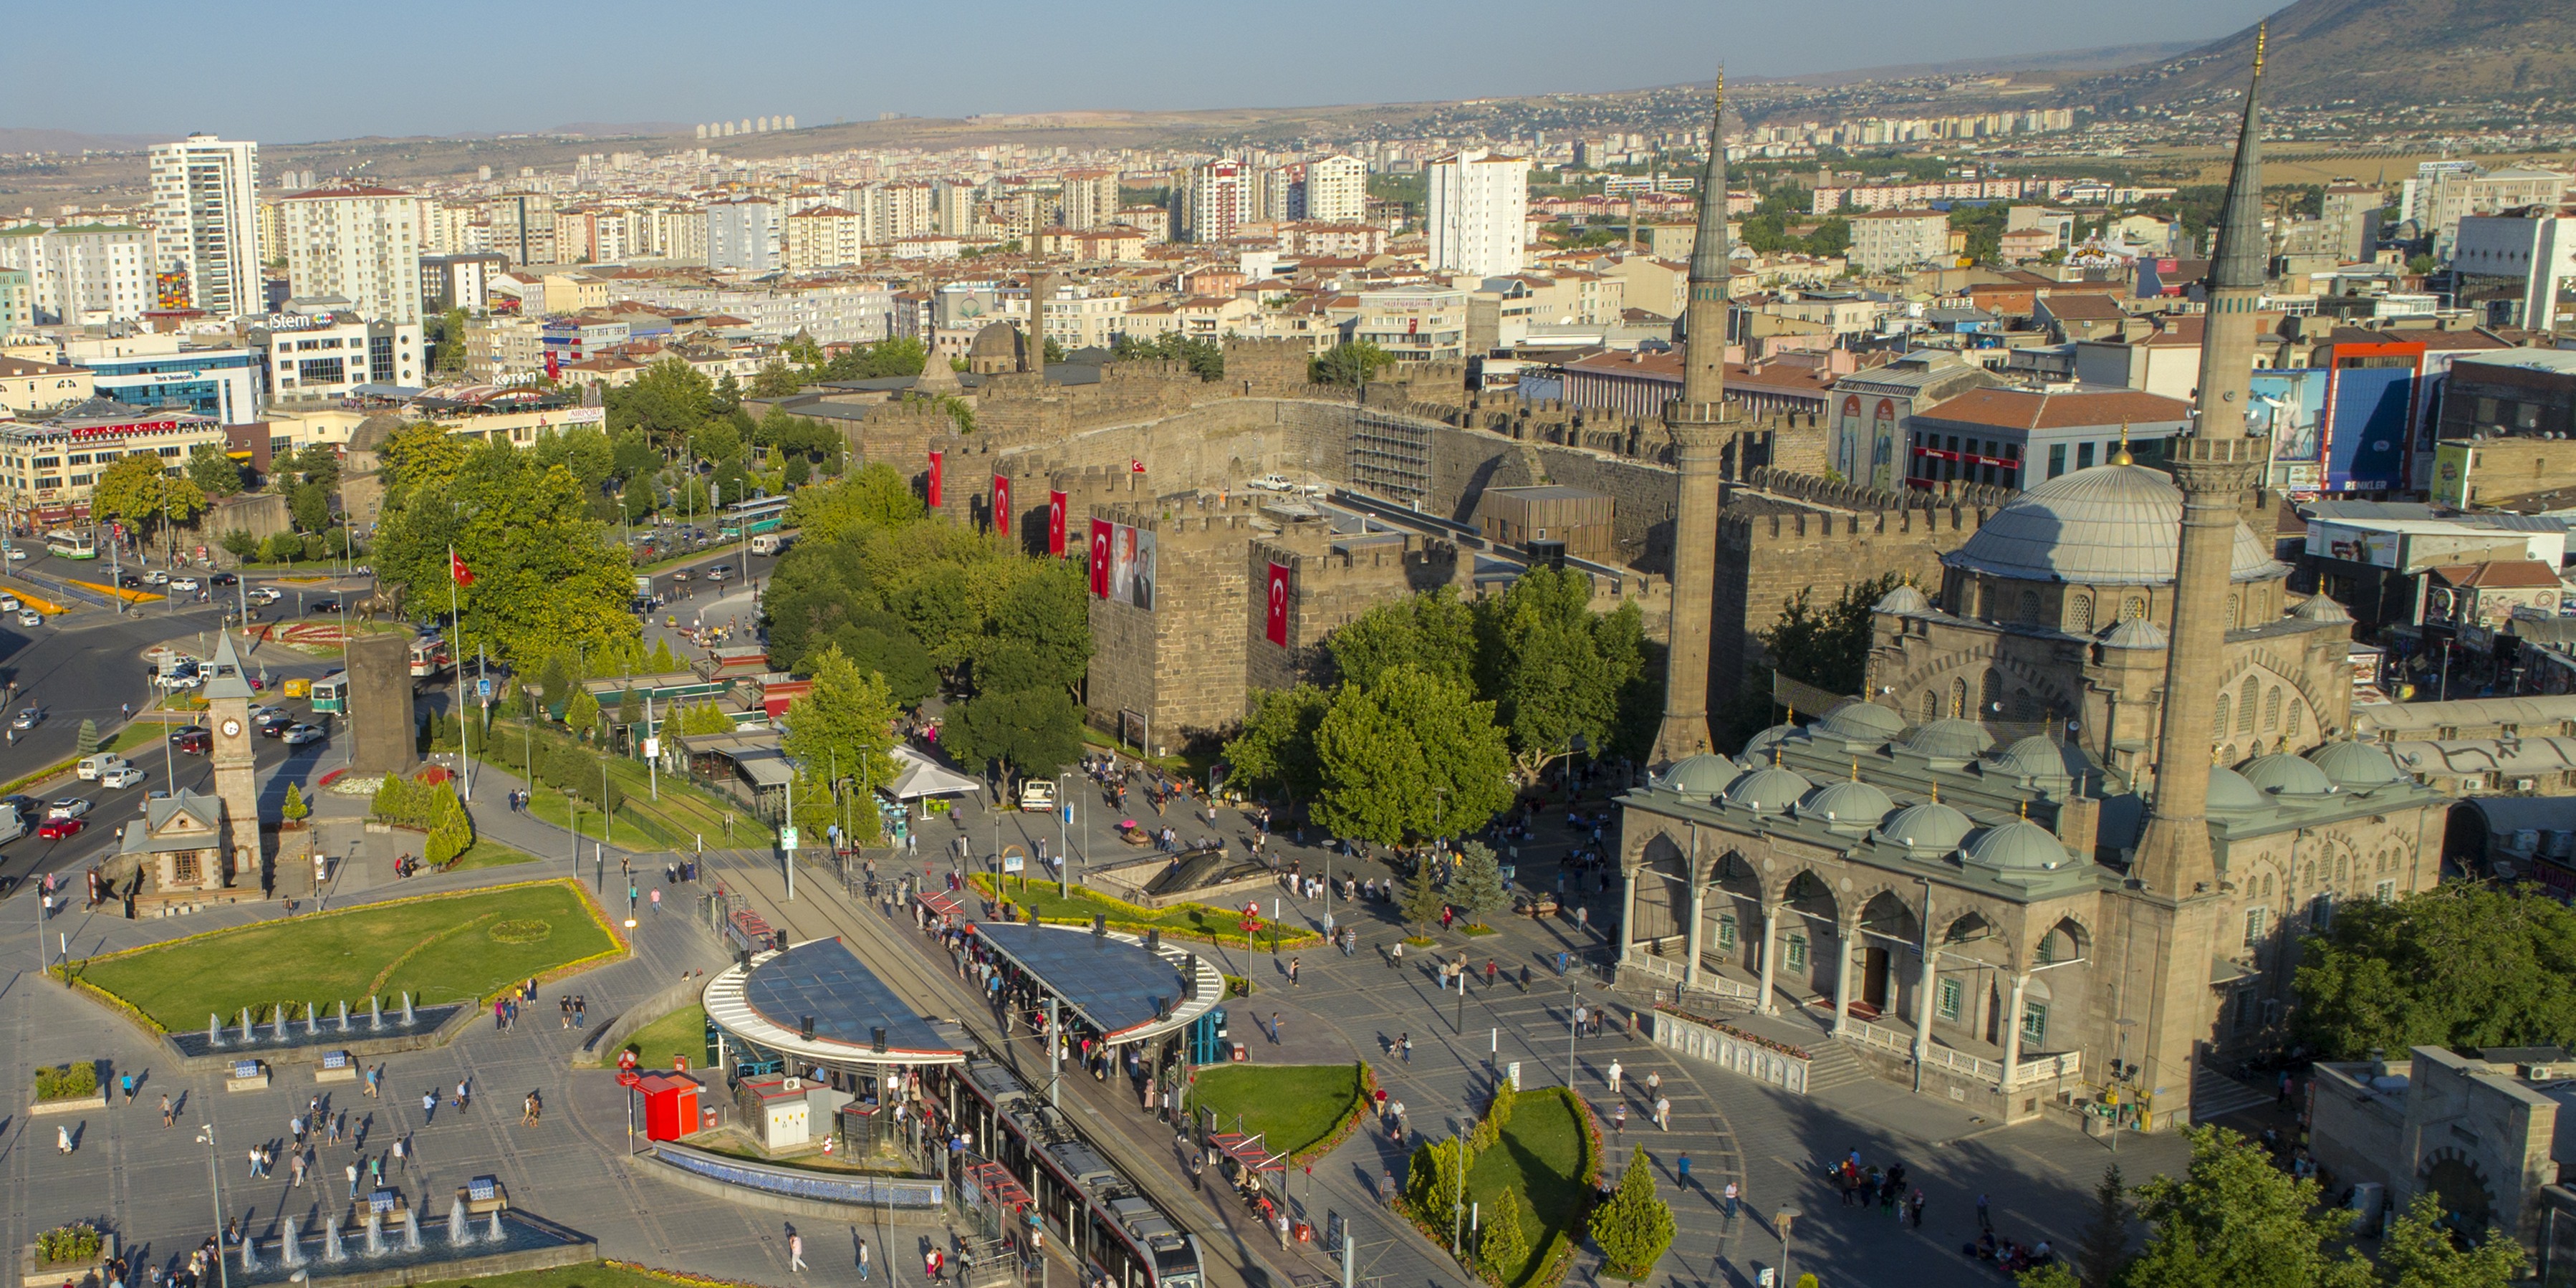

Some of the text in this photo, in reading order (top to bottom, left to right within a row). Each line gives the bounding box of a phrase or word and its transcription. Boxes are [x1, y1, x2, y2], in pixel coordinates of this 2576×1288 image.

[269, 314, 309, 329] iStem
[571, 408, 600, 417] AIRPORT
[2345, 480, 2387, 491] RENKLER
